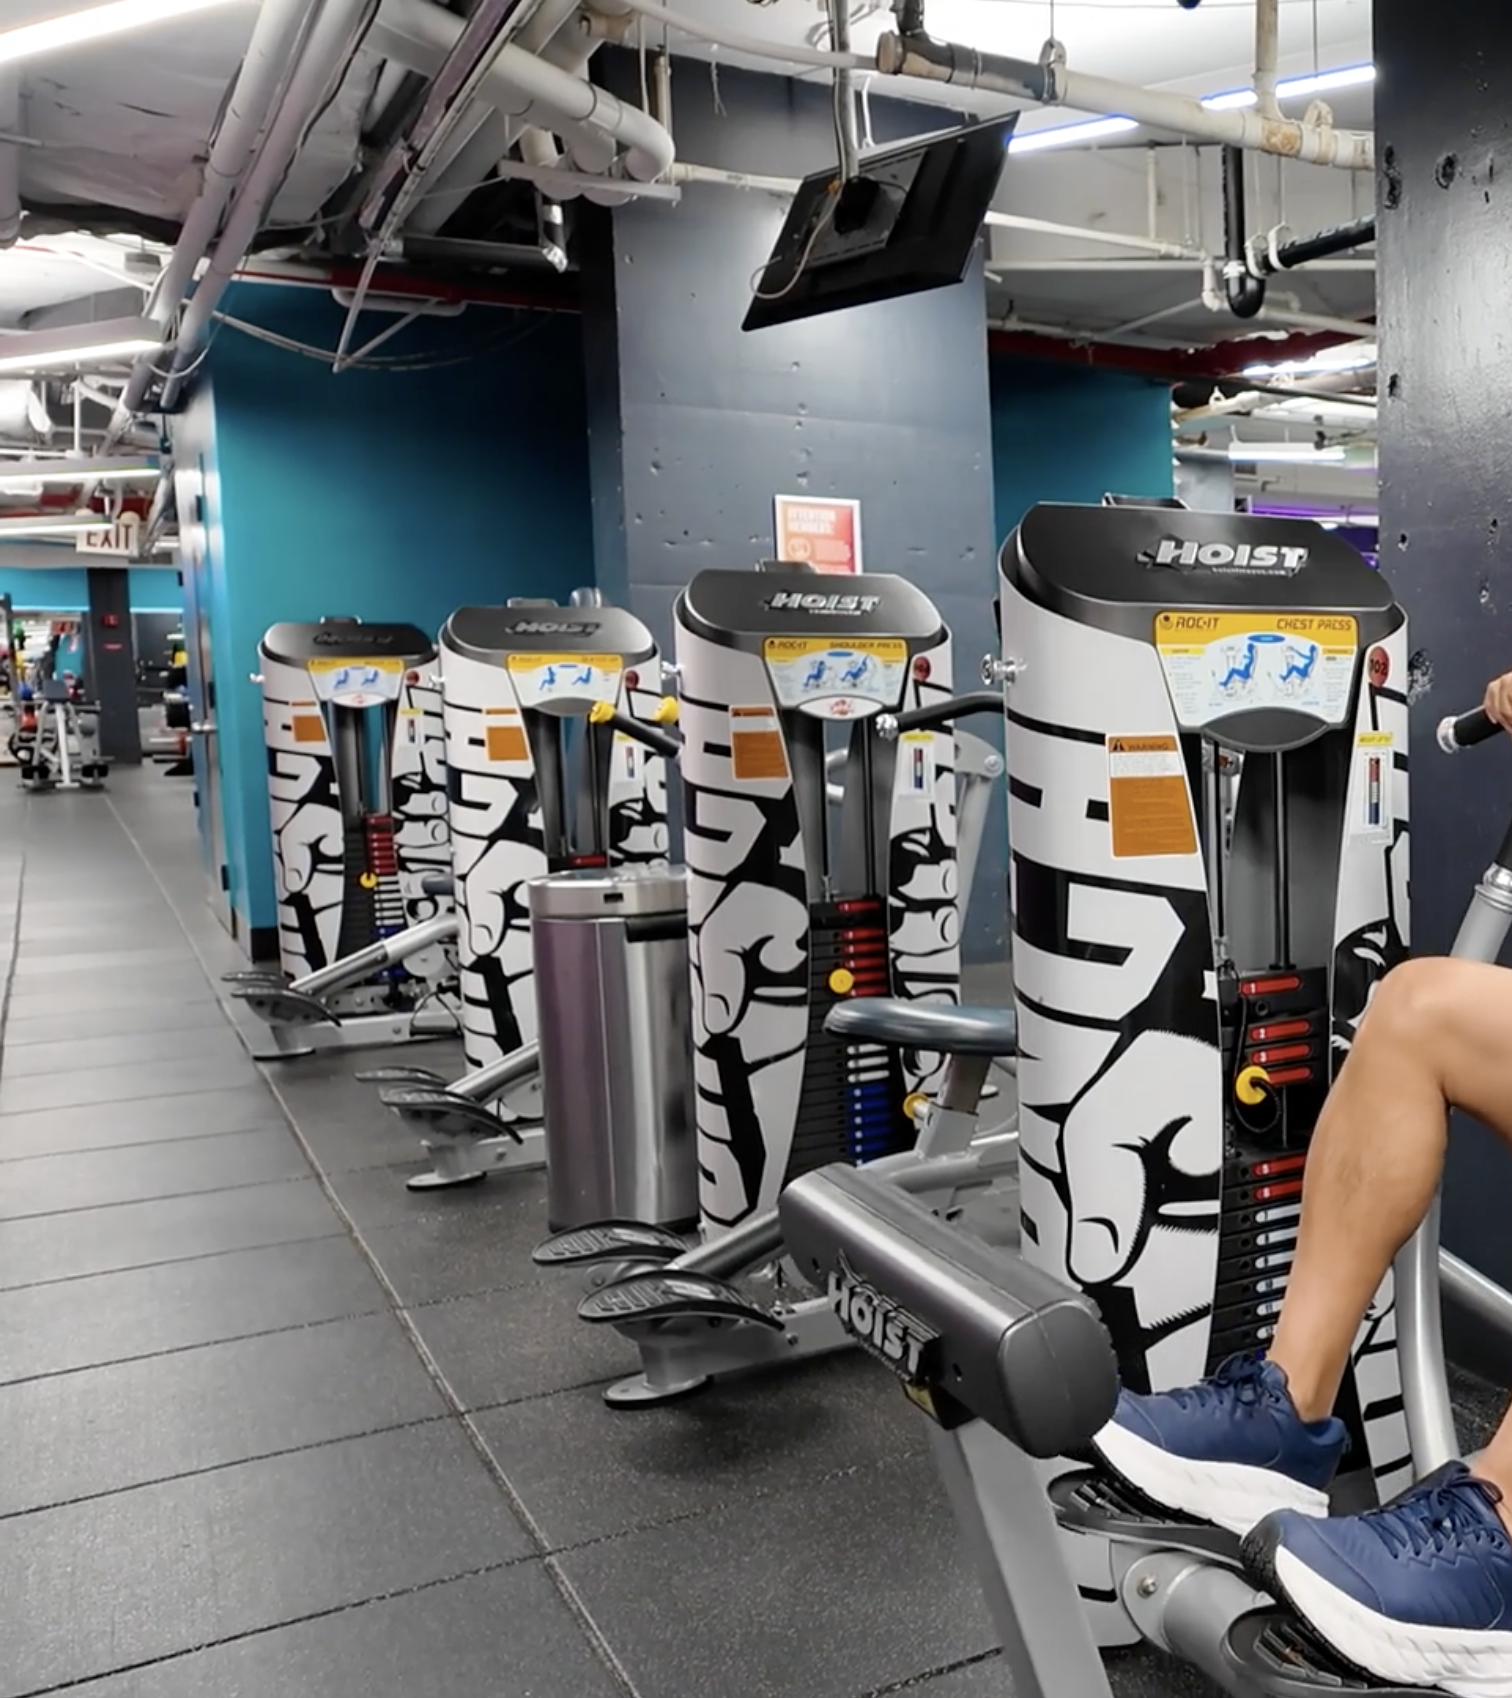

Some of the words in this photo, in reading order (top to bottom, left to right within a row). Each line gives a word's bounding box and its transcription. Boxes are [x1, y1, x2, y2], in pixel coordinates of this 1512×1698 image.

[86, 522, 133, 550] EXIT
[1155, 539, 1307, 568] HOIST
[771, 592, 880, 612] HOIST
[1276, 618, 1314, 630] CHEST
[1317, 619, 1352, 631] PRESS
[829, 641, 874, 650] SHOULDER
[1368, 657, 1388, 676] 102
[827, 1270, 924, 1375] HOIST
